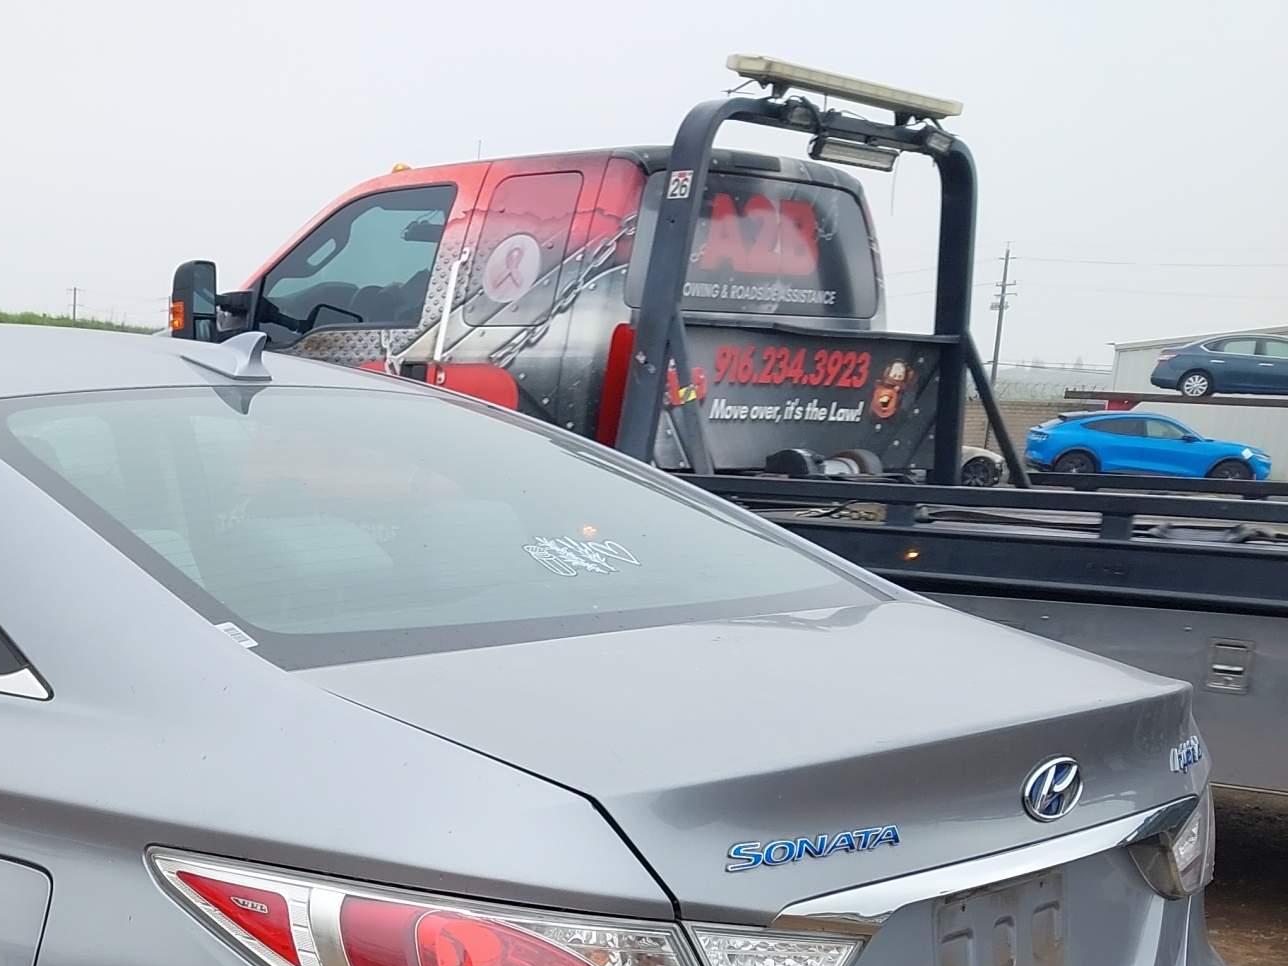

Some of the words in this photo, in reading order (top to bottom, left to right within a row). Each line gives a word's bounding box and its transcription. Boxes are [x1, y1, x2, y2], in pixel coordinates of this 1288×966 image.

[669, 177, 689, 197] 26
[683, 282, 719, 298] OWING
[720, 284, 729, 299] &
[778, 288, 837, 305] ASSISTANCE
[713, 345, 871, 389] 916.234.3923
[709, 399, 748, 420] Move
[750, 403, 782, 423] over,
[784, 400, 802, 421] it's
[804, 400, 827, 421] the
[829, 401, 865, 423] Law!
[726, 824, 901, 873] SONATA
